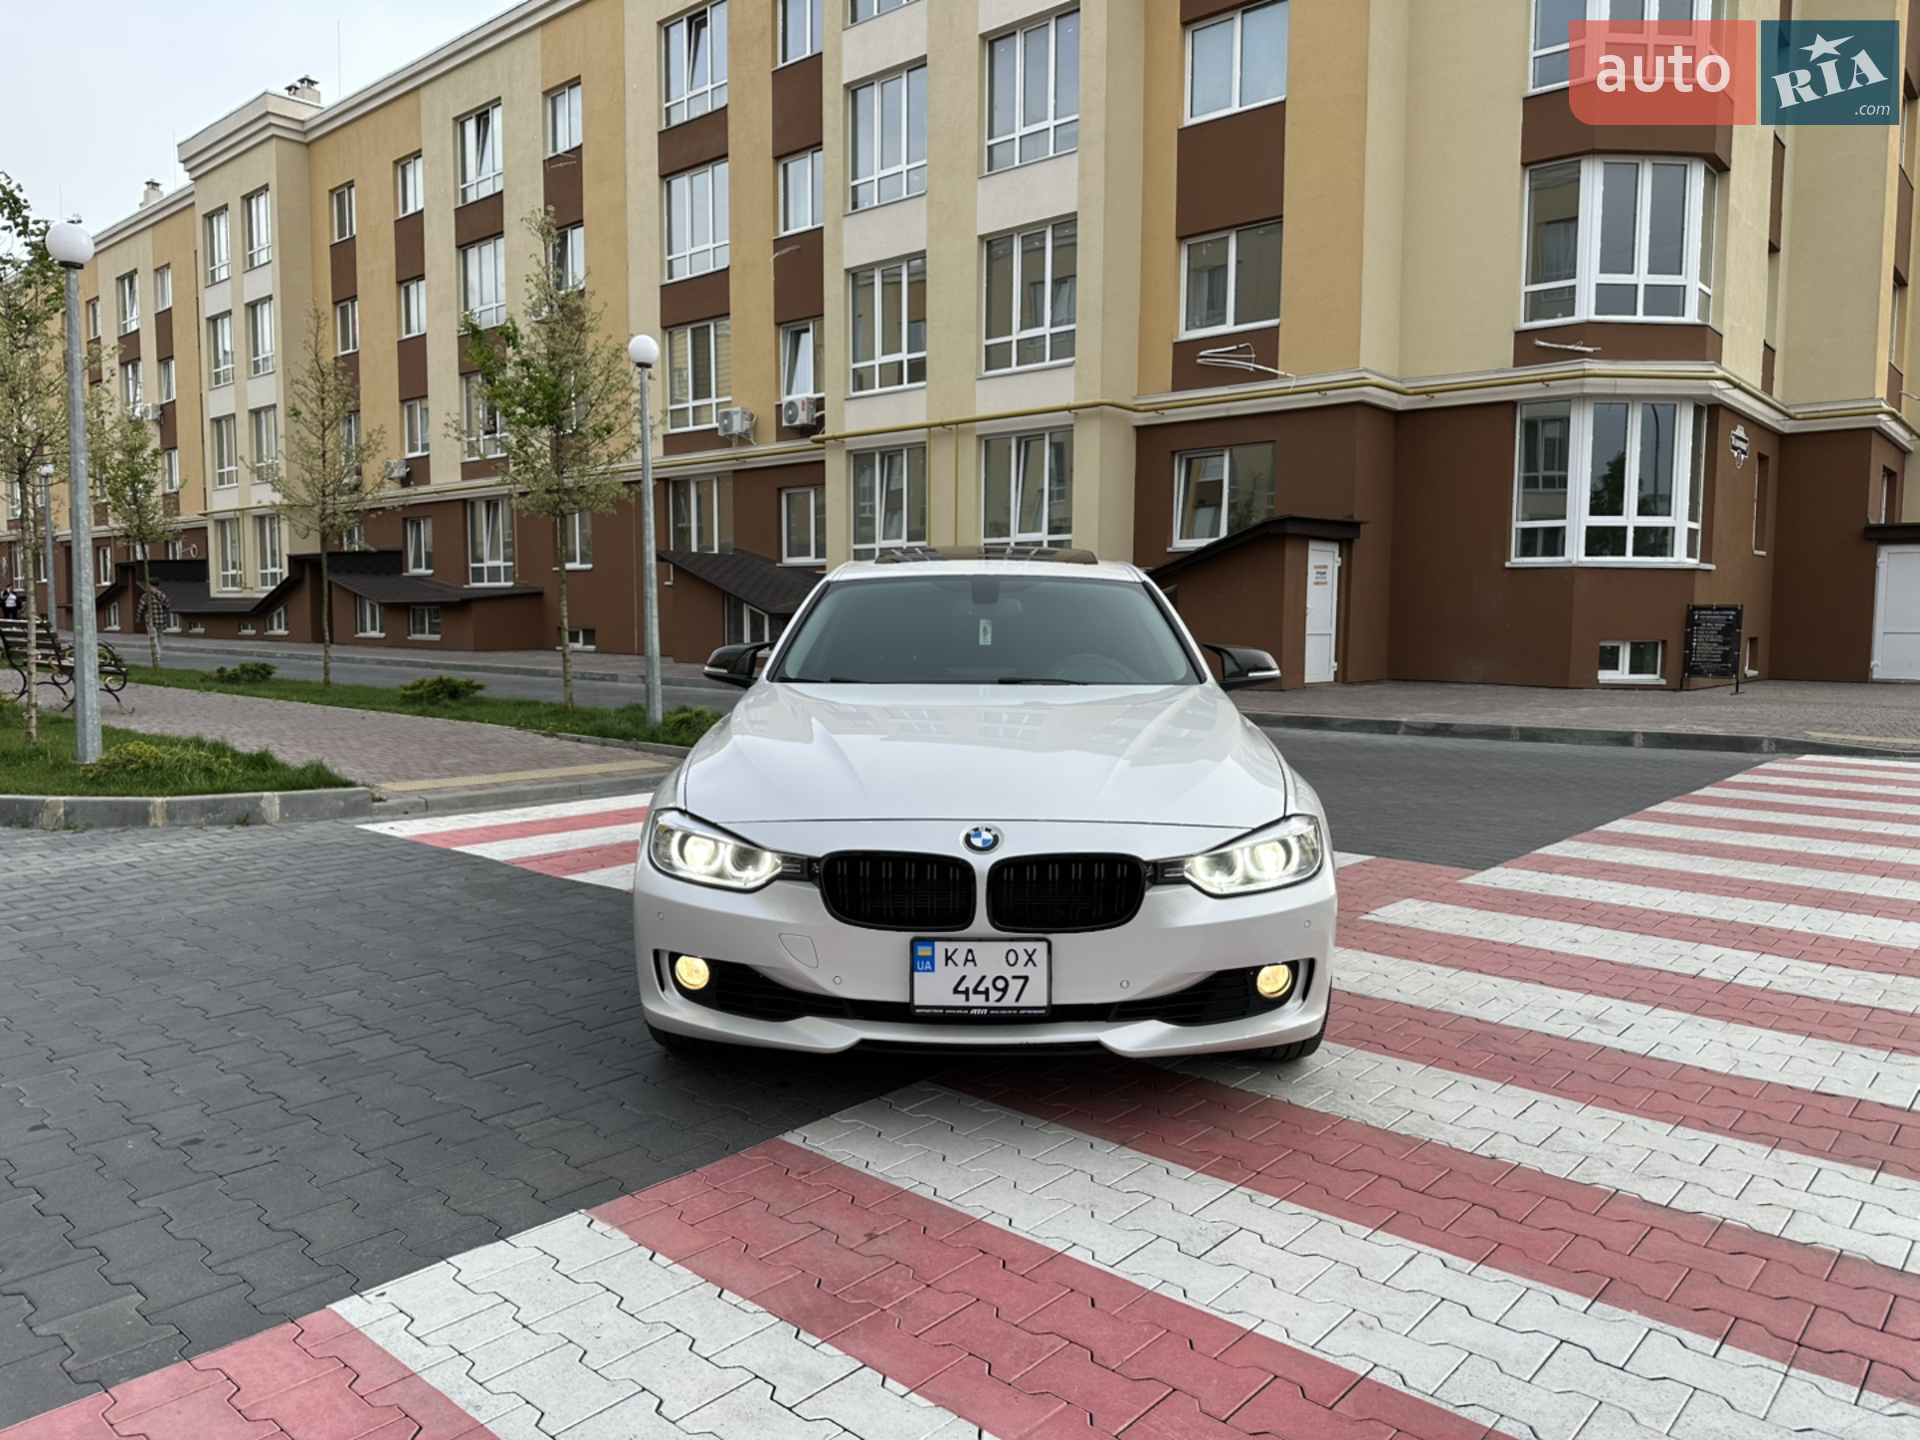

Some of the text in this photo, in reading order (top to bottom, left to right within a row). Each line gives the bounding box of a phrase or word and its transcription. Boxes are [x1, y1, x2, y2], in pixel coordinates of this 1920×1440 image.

[916, 960, 932, 971] UA
[944, 947, 977, 967] KA
[952, 974, 1030, 1003] 4497
